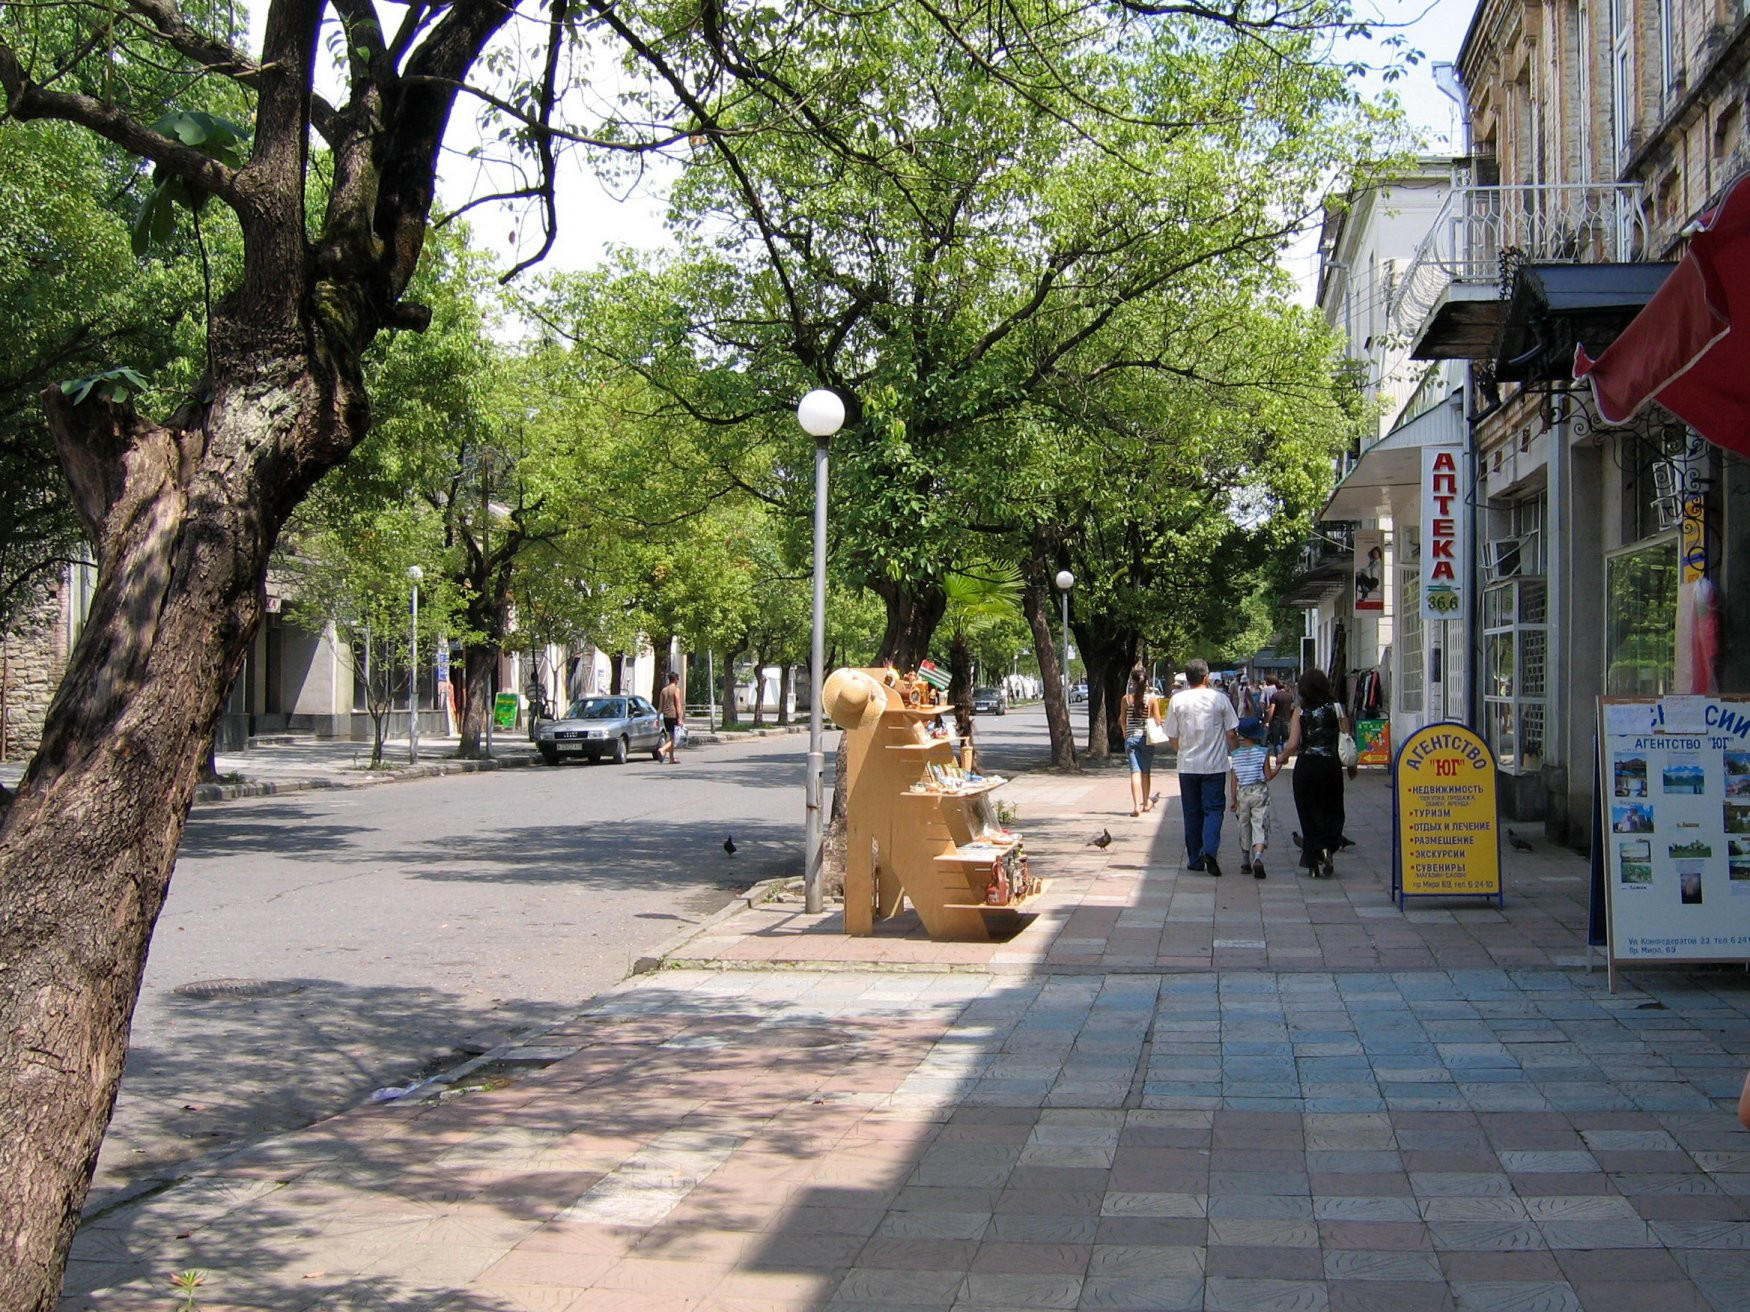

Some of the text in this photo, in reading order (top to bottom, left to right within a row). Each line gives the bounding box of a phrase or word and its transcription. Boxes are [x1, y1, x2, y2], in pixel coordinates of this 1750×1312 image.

[1431, 452, 1459, 580] АПТЕКА
[1635, 738, 1701, 749] АГЕНТСТВО
[1406, 734, 1488, 771] АГЕНТСТВО
[1430, 759, 1465, 776] "ЮГ"
[1412, 785, 1484, 795] НЕДВИЖИМОСТЬ
[1414, 809, 1451, 817] ТУРИЗМ
[1414, 821, 1491, 832] ОТДЫХ И ЛЕЧЕНИЕ
[1414, 836, 1474, 846] РАЗМЕЩЕНИЕ
[1415, 849, 1466, 858] ЭКСКУРСИИ
[1416, 863, 1466, 872] СУВЕНИРЫ
